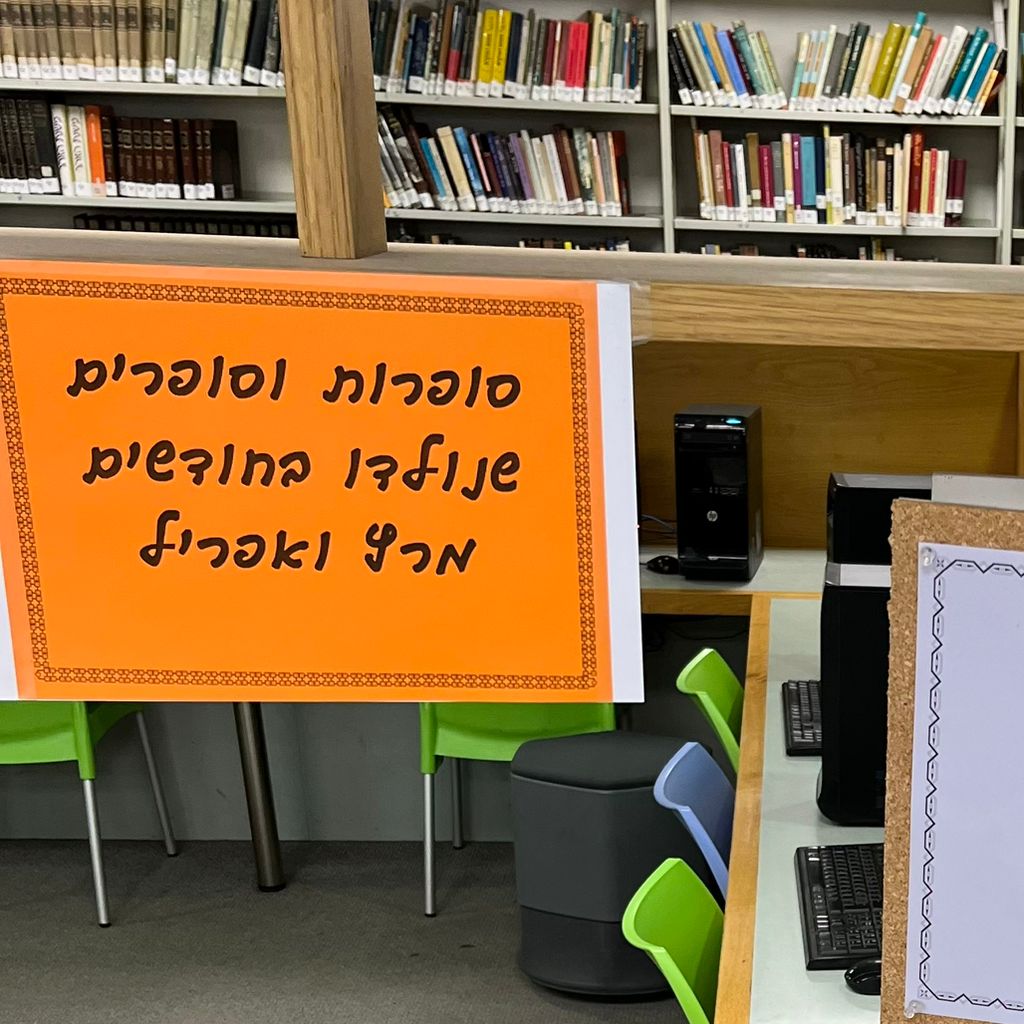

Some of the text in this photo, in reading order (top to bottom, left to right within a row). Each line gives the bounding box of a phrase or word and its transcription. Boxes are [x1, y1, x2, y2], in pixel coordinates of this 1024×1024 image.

[67, 353, 521, 408] סופרות וסופרים
[82, 434, 520, 501] שנולדו בחודשים
[140, 510, 477, 576] מרץ ואפריל
